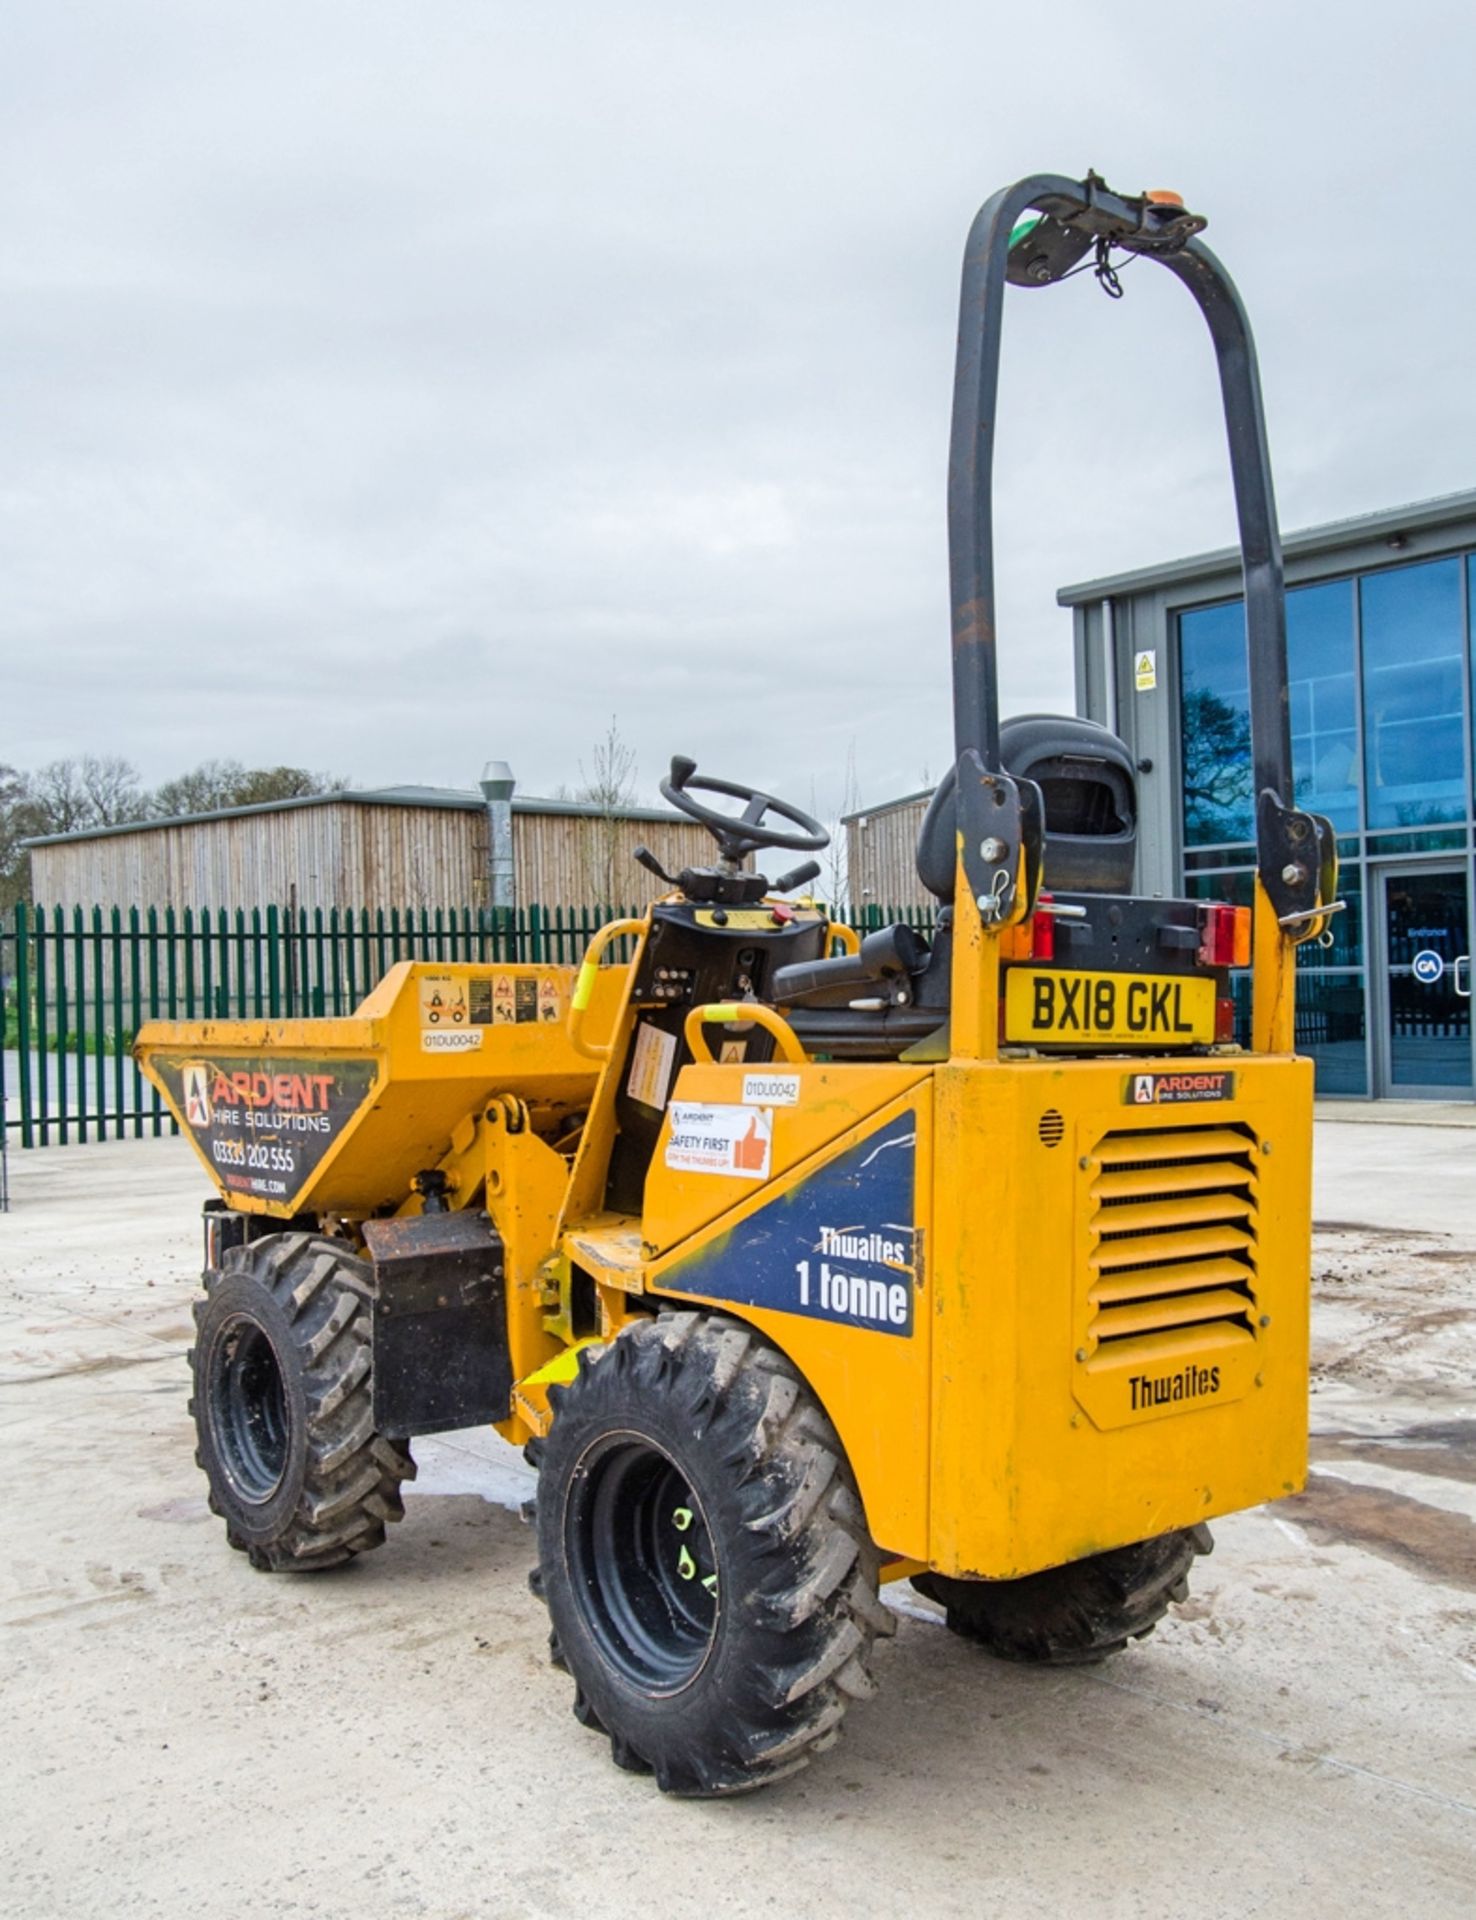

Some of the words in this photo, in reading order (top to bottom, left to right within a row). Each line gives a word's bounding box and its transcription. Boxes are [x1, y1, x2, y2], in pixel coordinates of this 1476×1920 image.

[1032, 977, 1115, 1030] BX18
[1127, 981, 1193, 1032] GKL
[425, 1034, 480, 1047] 01DU0042
[212, 1072, 334, 1110] ARDENT
[746, 1081, 797, 1098] 01DU0042
[1158, 1075, 1225, 1091] ARDENT
[1177, 1090, 1222, 1099] SOLUTIONS
[213, 1108, 240, 1126] HIRE
[245, 1111, 331, 1132] SOLUTIONS
[213, 1140, 246, 1166] 03333
[247, 1144, 270, 1169] 202
[271, 1149, 294, 1172] 555
[703, 1137, 730, 1151] FIRST
[819, 1226, 905, 1265] Thwaites
[796, 1260, 809, 1306] 1
[821, 1263, 907, 1325] tonne
[1128, 1364, 1221, 1411] Thwaites
